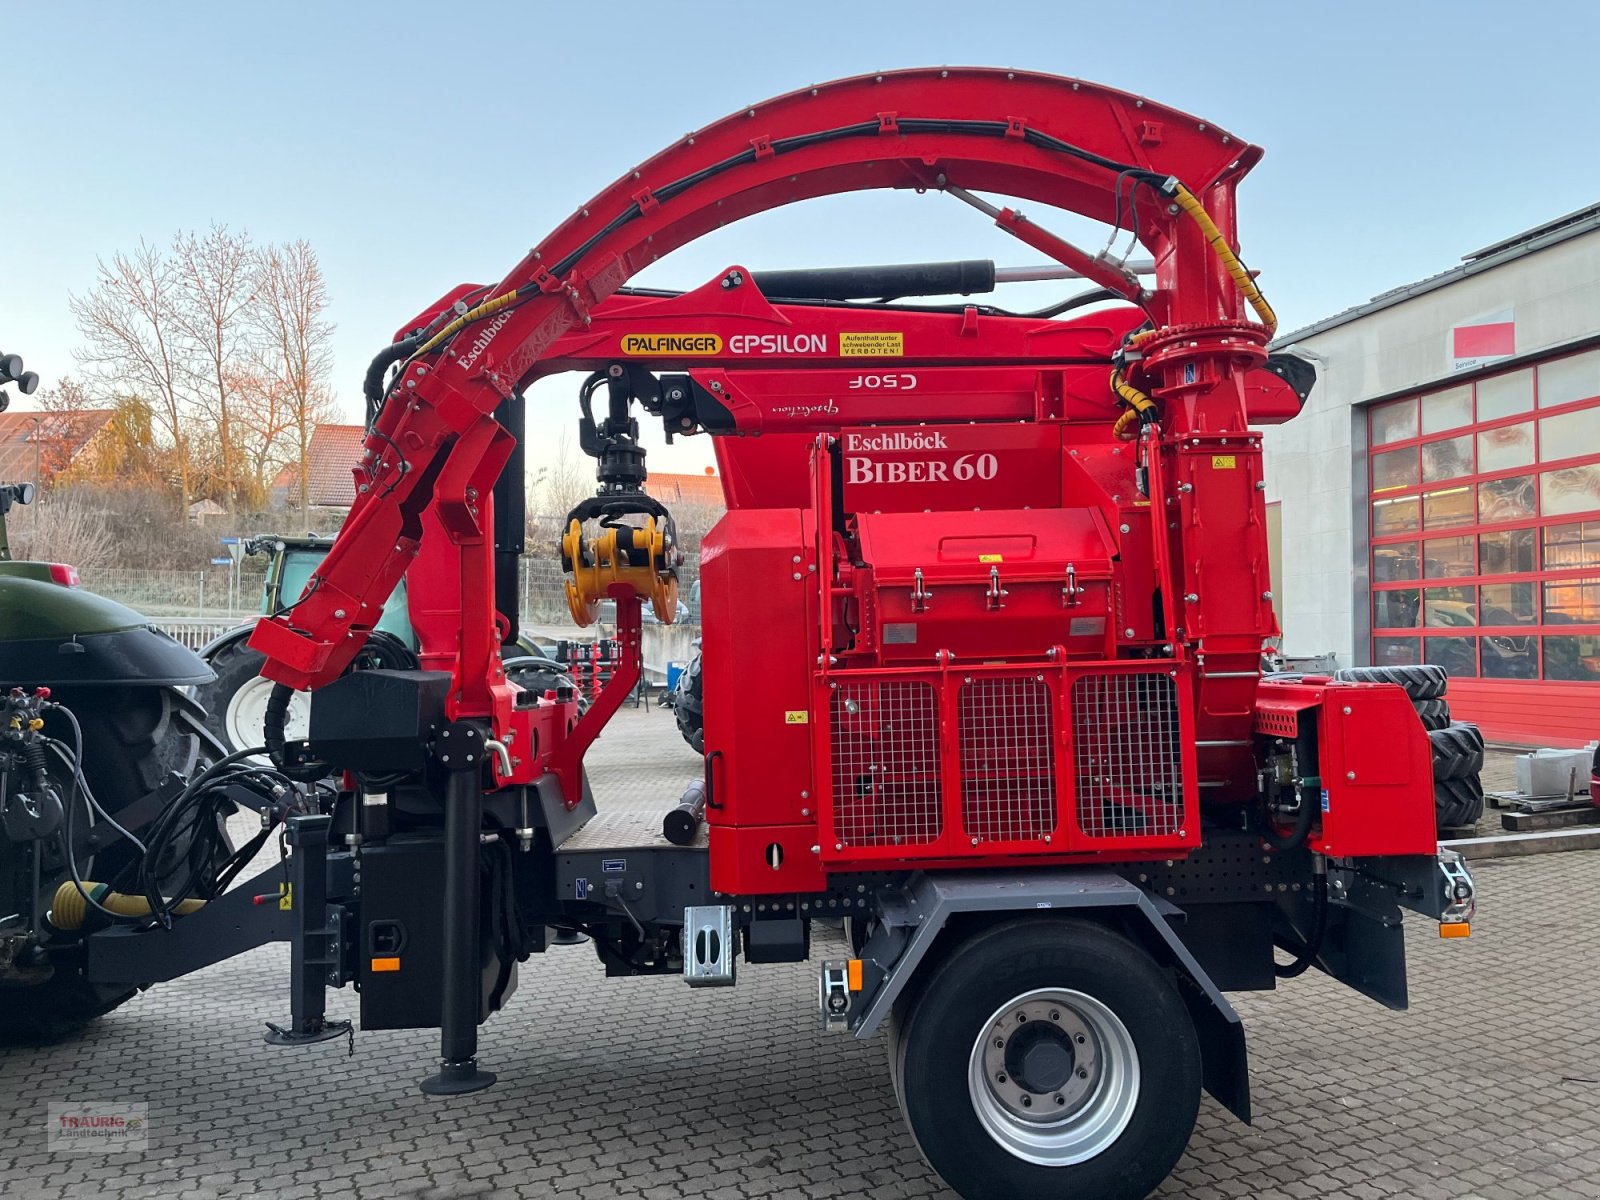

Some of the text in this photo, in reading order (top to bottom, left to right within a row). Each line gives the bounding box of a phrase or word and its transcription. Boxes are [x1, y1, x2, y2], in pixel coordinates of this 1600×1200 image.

[626, 336, 717, 352] PALFINGER
[728, 334, 827, 354] EPSILON
[1455, 359, 1477, 370] Service
[848, 374, 918, 390] C50F
[846, 431, 948, 452] Eschlböck
[952, 453, 999, 481] 60
